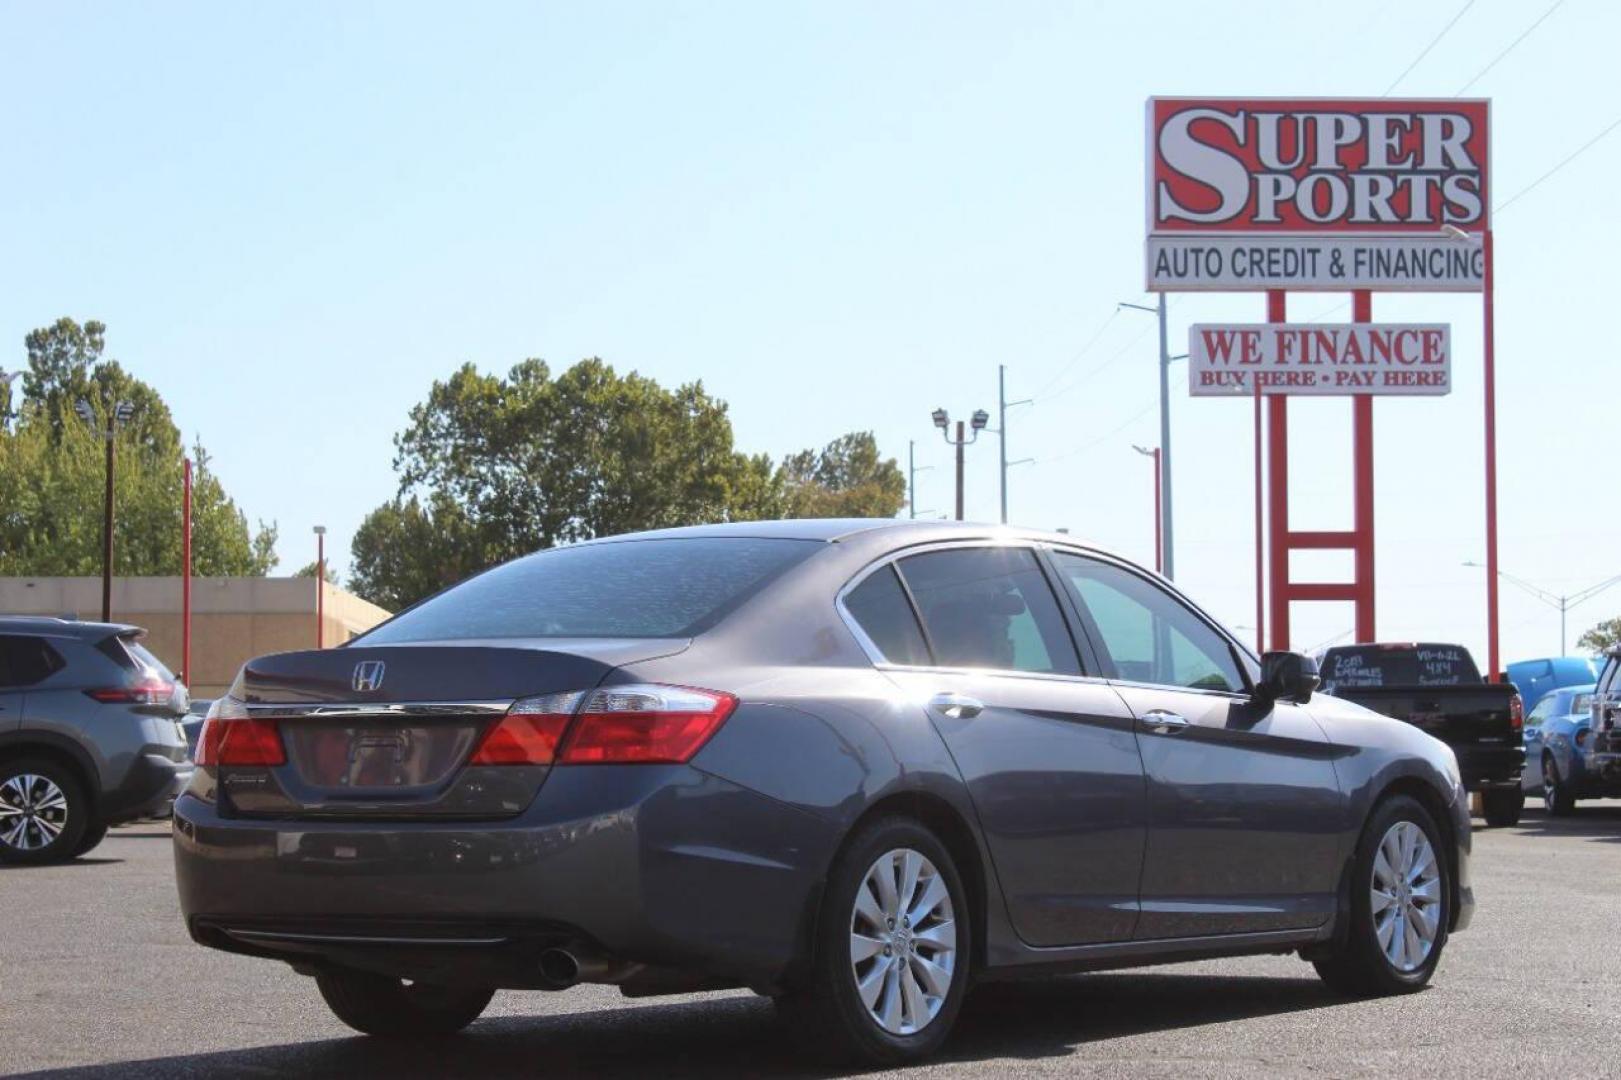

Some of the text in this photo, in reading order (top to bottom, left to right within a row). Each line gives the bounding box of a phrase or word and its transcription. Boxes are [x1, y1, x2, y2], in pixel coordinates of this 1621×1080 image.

[1159, 108, 1479, 224] SUPER
[1155, 248, 1483, 279] AUTO CREDIT & FINANCING
[1201, 330, 1445, 365] WE FINANCE
[1201, 371, 1447, 386] BUY HERE PAY HERE
